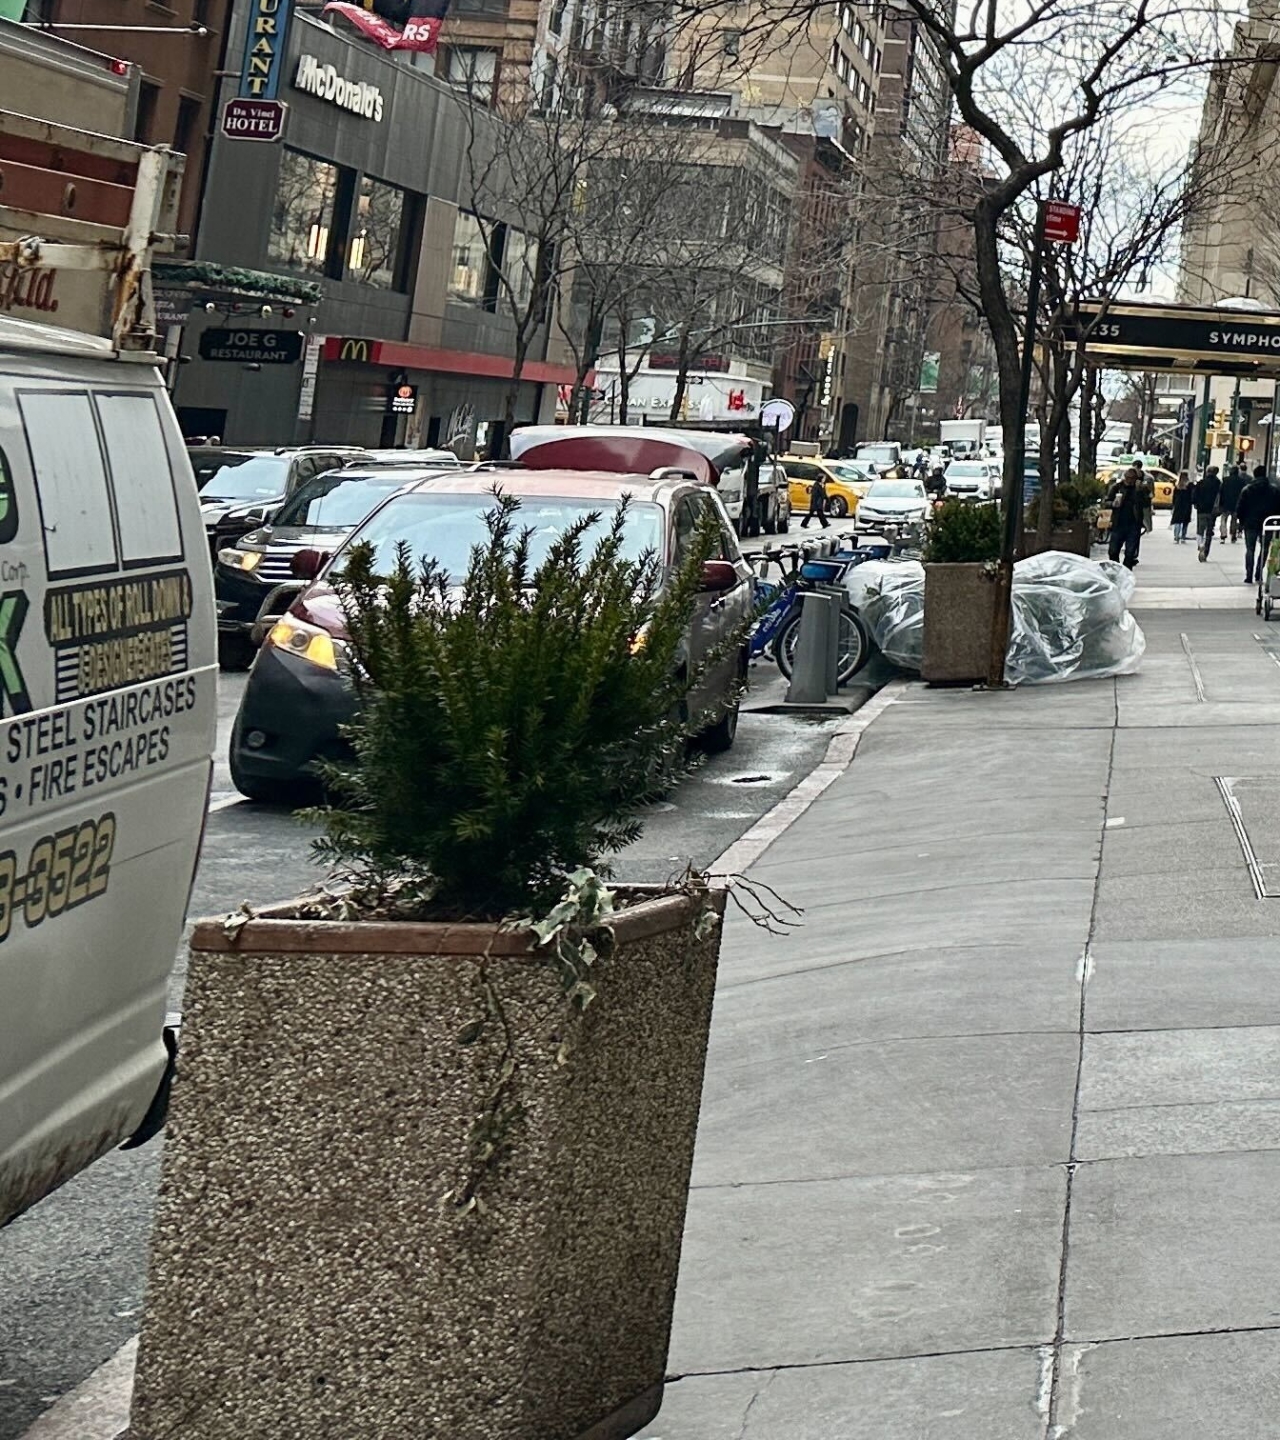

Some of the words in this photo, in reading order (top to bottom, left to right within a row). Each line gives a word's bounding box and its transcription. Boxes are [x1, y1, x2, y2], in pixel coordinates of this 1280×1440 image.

[295, 54, 384, 123] McDonald's
[232, 107, 247, 116] Da
[250, 108, 275, 118] Vinci
[226, 117, 278, 133] HOTEL
[225, 332, 259, 347] JOE
[263, 333, 278, 347] G
[210, 348, 288, 361] RESTAURANT
[604, 395, 646, 408] CUAN
[7, 711, 77, 764] STEEL
[83, 675, 196, 742] STAIRCASES
[28, 754, 78, 807] FIRE
[82, 725, 170, 788] ESCAPES
